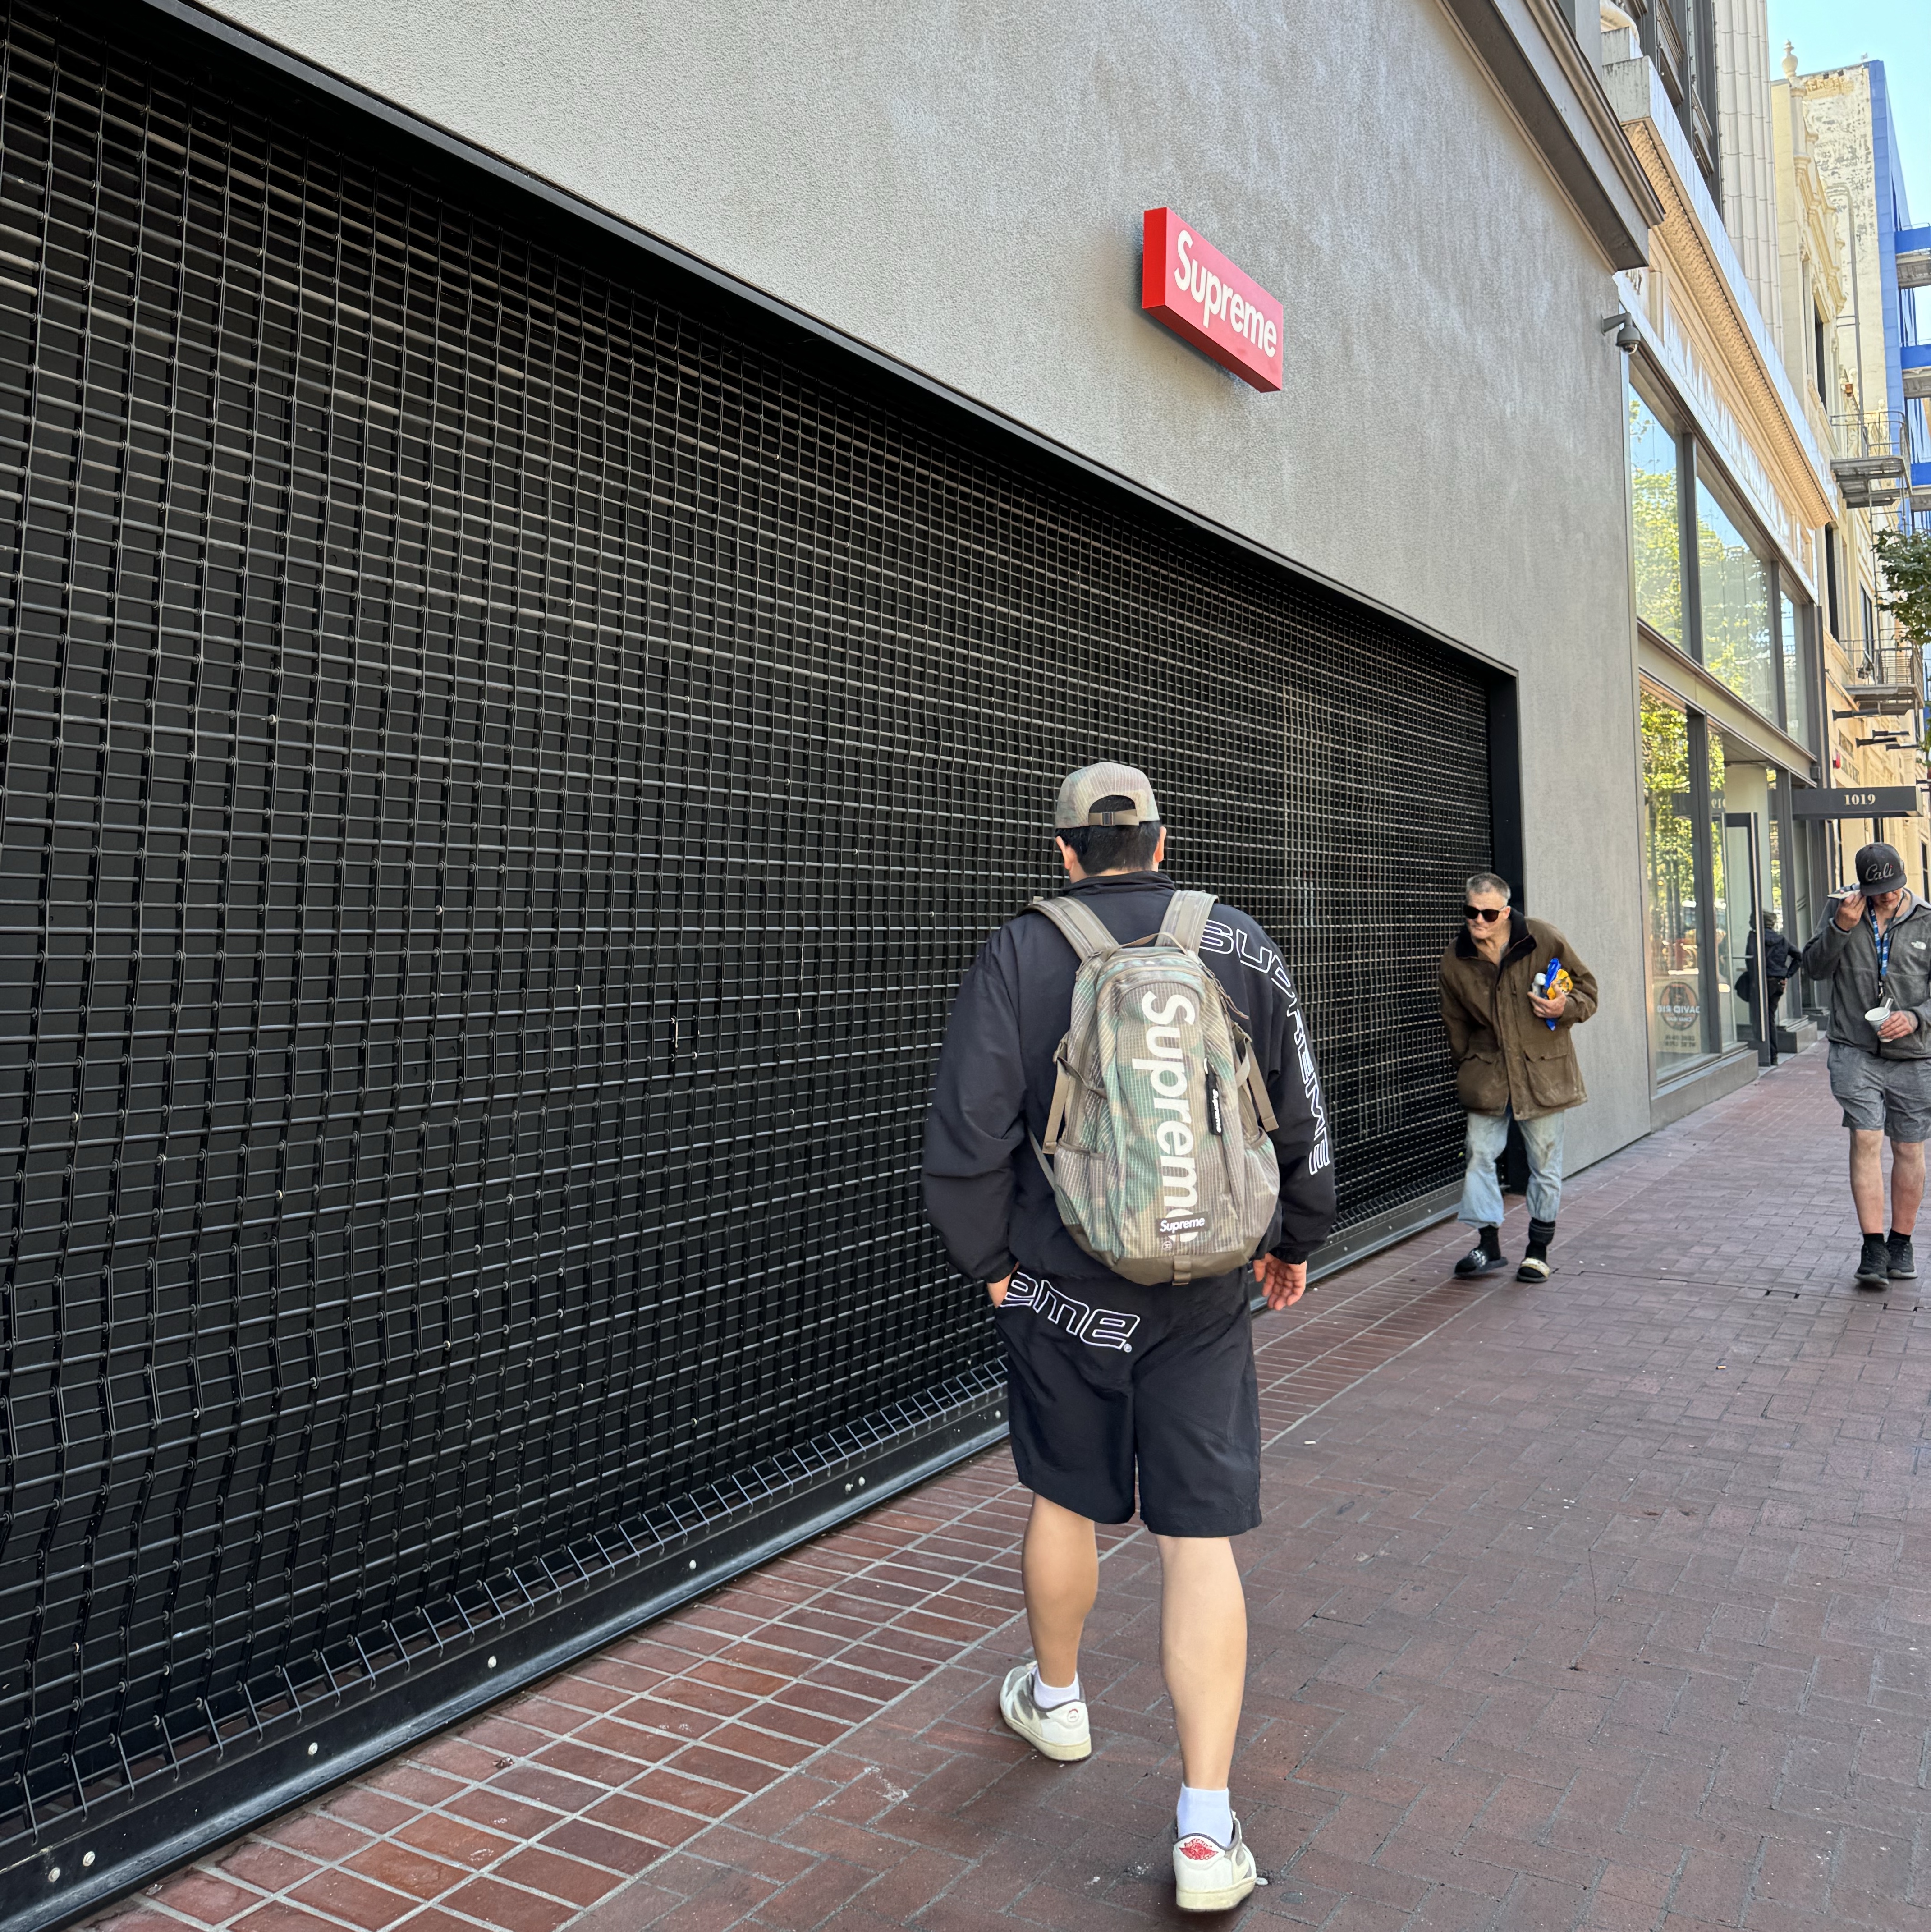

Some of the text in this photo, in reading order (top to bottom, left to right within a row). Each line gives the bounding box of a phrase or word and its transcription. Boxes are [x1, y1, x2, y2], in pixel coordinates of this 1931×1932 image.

[1174, 230, 1277, 358] Supreme
[1844, 794, 1876, 805] 1019
[1865, 863, 1894, 881] Cali
[1160, 1217, 1205, 1233] Supreme
